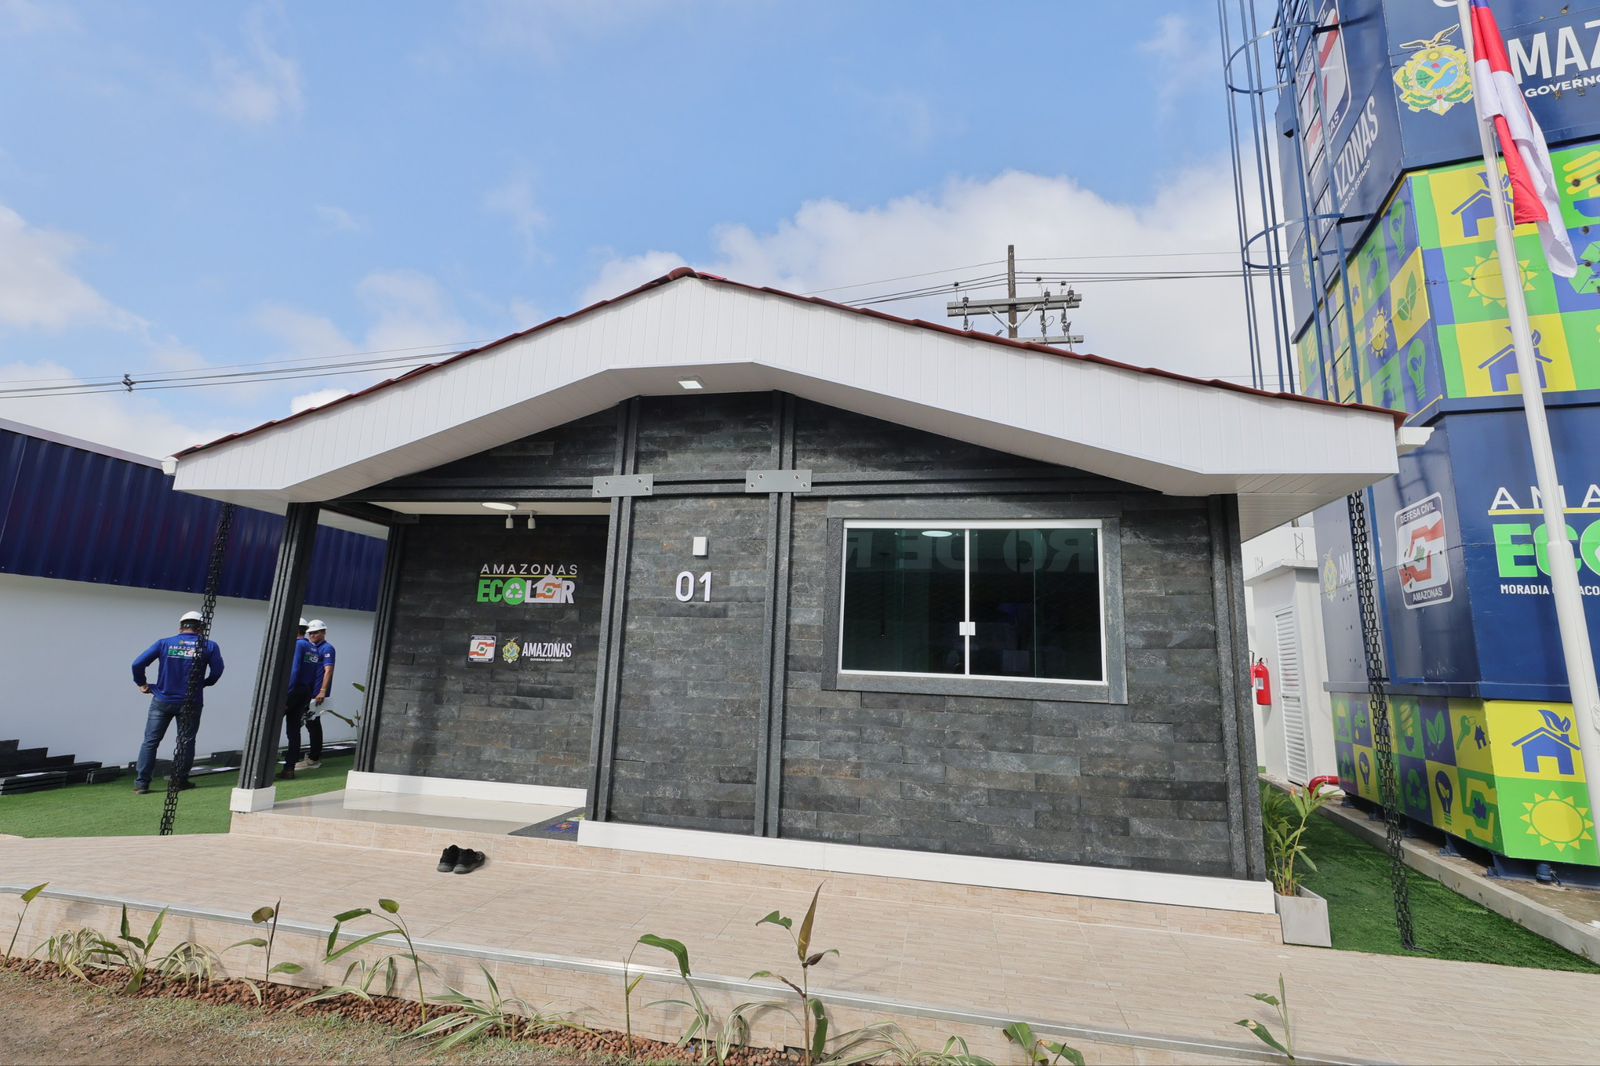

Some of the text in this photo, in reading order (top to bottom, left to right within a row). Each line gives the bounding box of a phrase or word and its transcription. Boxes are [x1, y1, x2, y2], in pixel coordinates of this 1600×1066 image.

[1399, 501, 1436, 524] DEFESA CIVIL
[480, 563, 578, 575] AMAZONAS
[675, 570, 712, 602] 01
[1500, 584, 1550, 595] MORADIA
[1412, 587, 1443, 602] AMAZONAS
[521, 641, 573, 658] AMAZONAS
